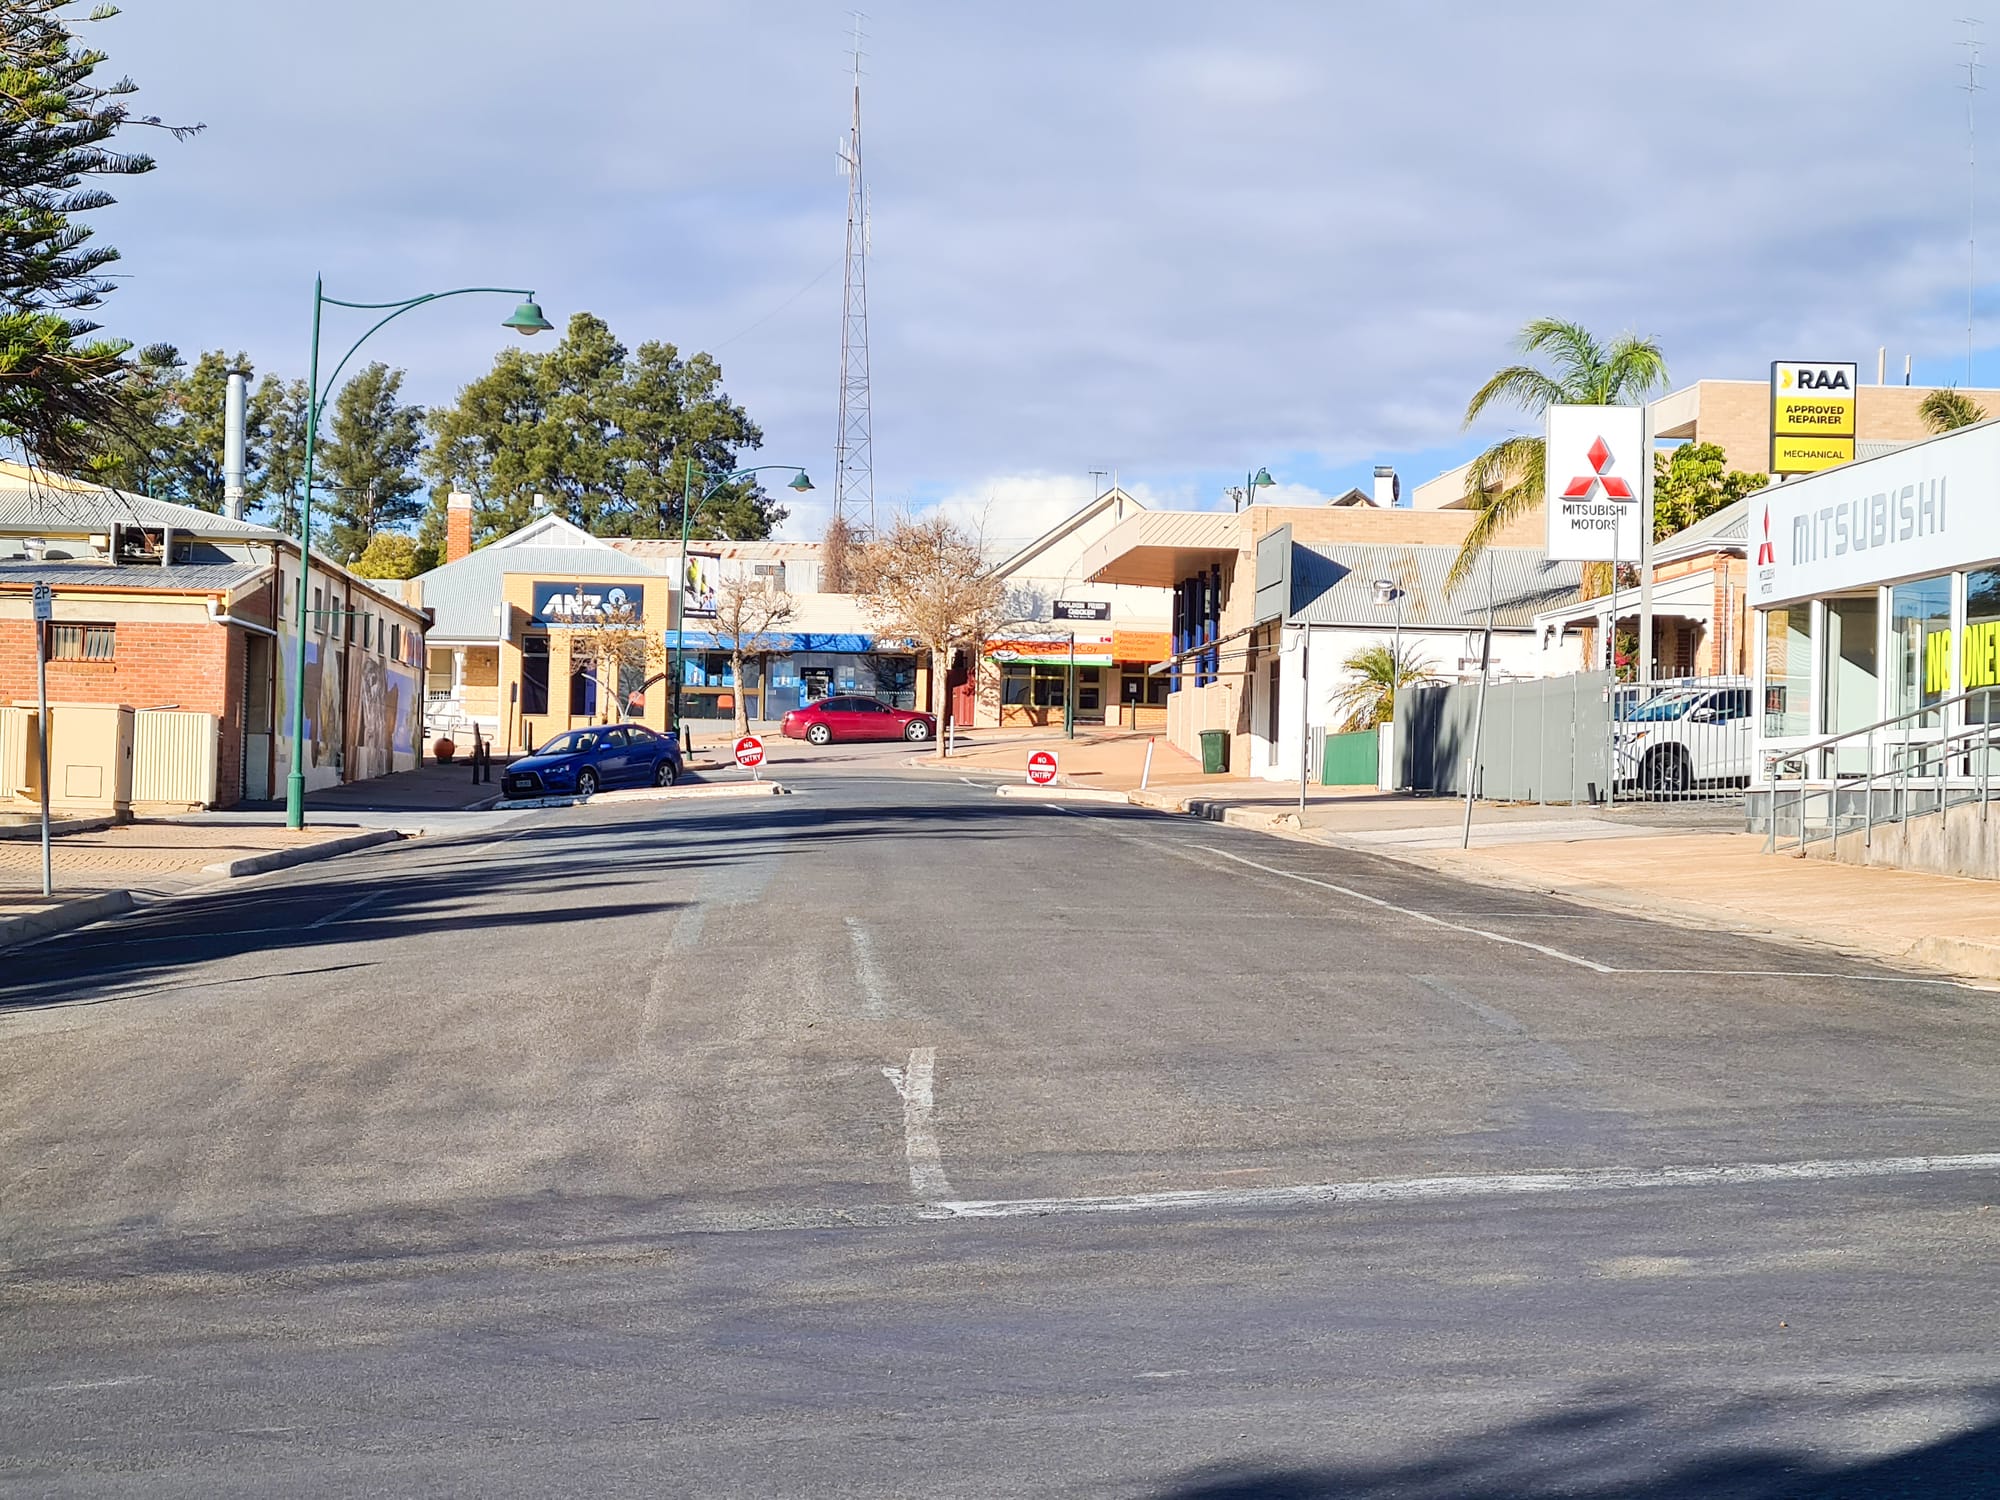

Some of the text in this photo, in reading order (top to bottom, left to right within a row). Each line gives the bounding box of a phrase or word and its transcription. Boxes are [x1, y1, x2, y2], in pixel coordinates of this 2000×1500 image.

[1797, 369, 1850, 390] RAA
[1785, 405, 1845, 415] APPROVED
[1788, 415, 1842, 424] REPAIRER
[1783, 450, 1845, 459] MECHANICAL
[1562, 504, 1627, 516] MITSUBISHI
[1571, 519, 1617, 530] MOTORS
[1792, 475, 1947, 567] MITSUBISHI
[34, 586, 50, 599] 2P
[541, 593, 604, 615] ANZ
[740, 753, 761, 764] ENTRY
[1031, 771, 1051, 779] ENTRY
